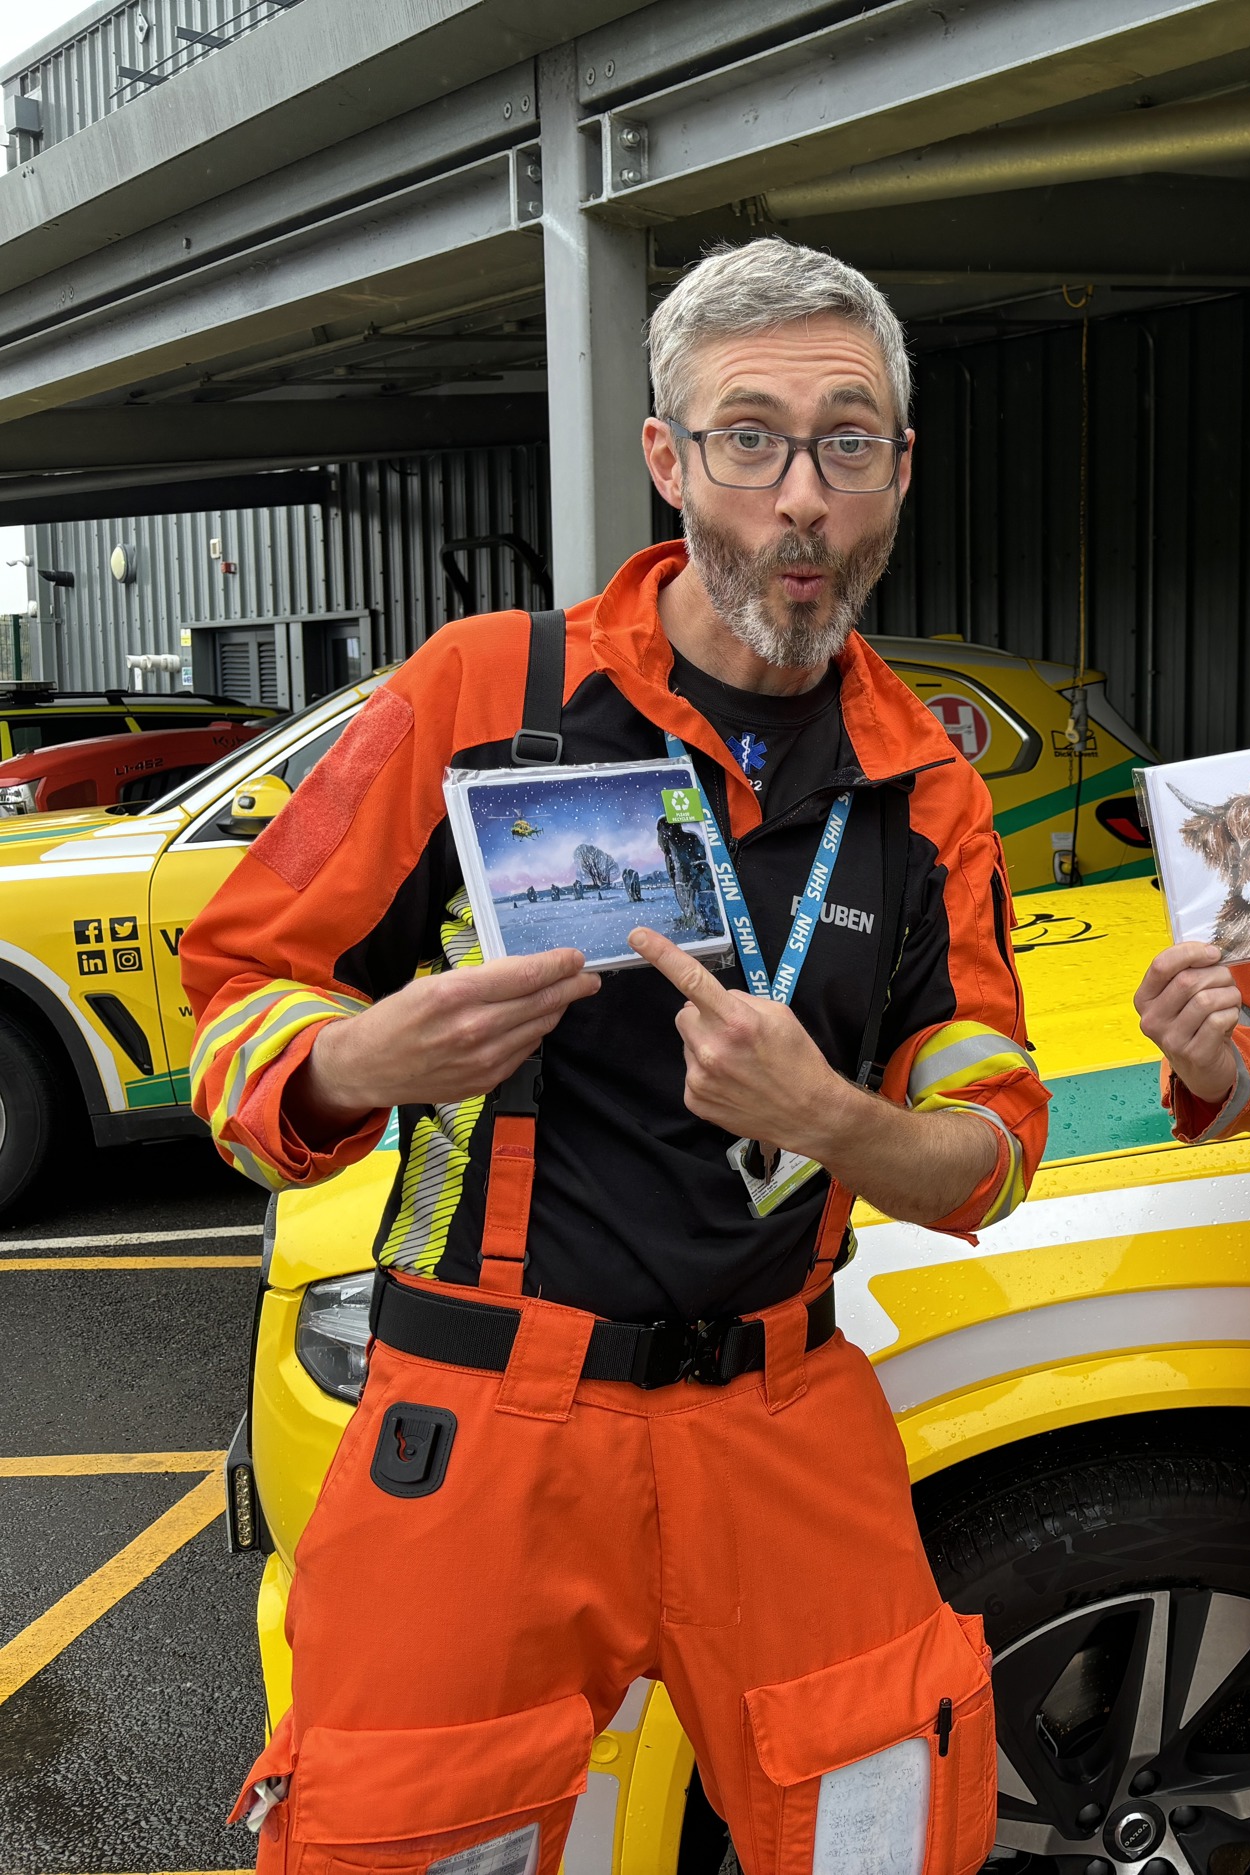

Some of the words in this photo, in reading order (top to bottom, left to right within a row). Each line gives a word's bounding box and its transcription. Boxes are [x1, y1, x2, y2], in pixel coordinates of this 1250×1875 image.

[823, 813, 844, 854] NHS
[715, 862, 742, 901] NHS
[807, 862, 829, 902] NHS
[733, 916, 758, 955] NHS
[789, 912, 813, 953] NHS
[1124, 1823, 1149, 1847] VOLVO
